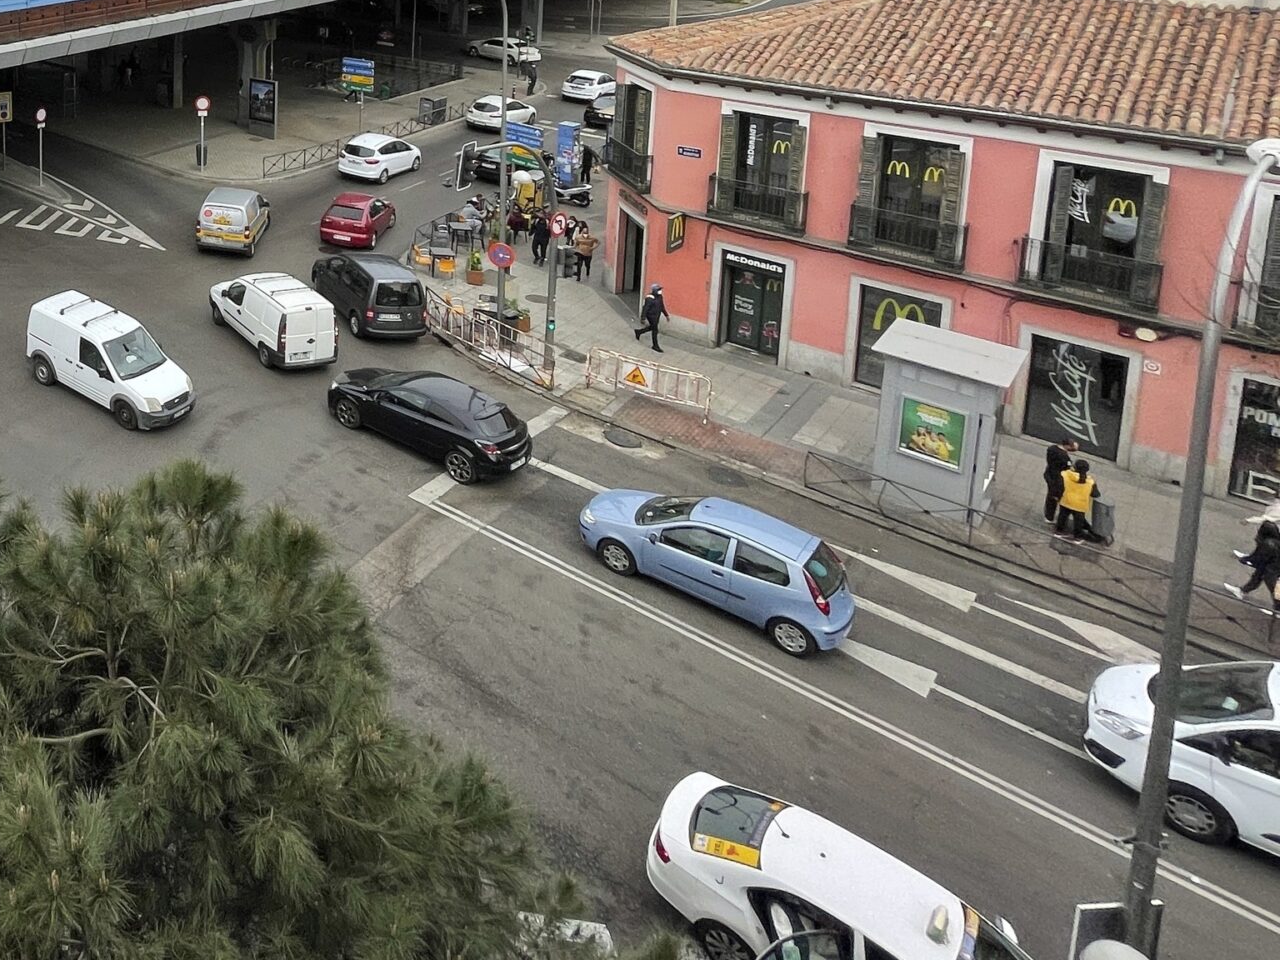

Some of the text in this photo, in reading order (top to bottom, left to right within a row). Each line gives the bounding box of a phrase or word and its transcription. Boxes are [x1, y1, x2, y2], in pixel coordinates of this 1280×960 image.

[746, 123, 757, 166] McDonald's
[725, 253, 784, 273] McDonald's
[1048, 348, 1099, 447] McCafé
